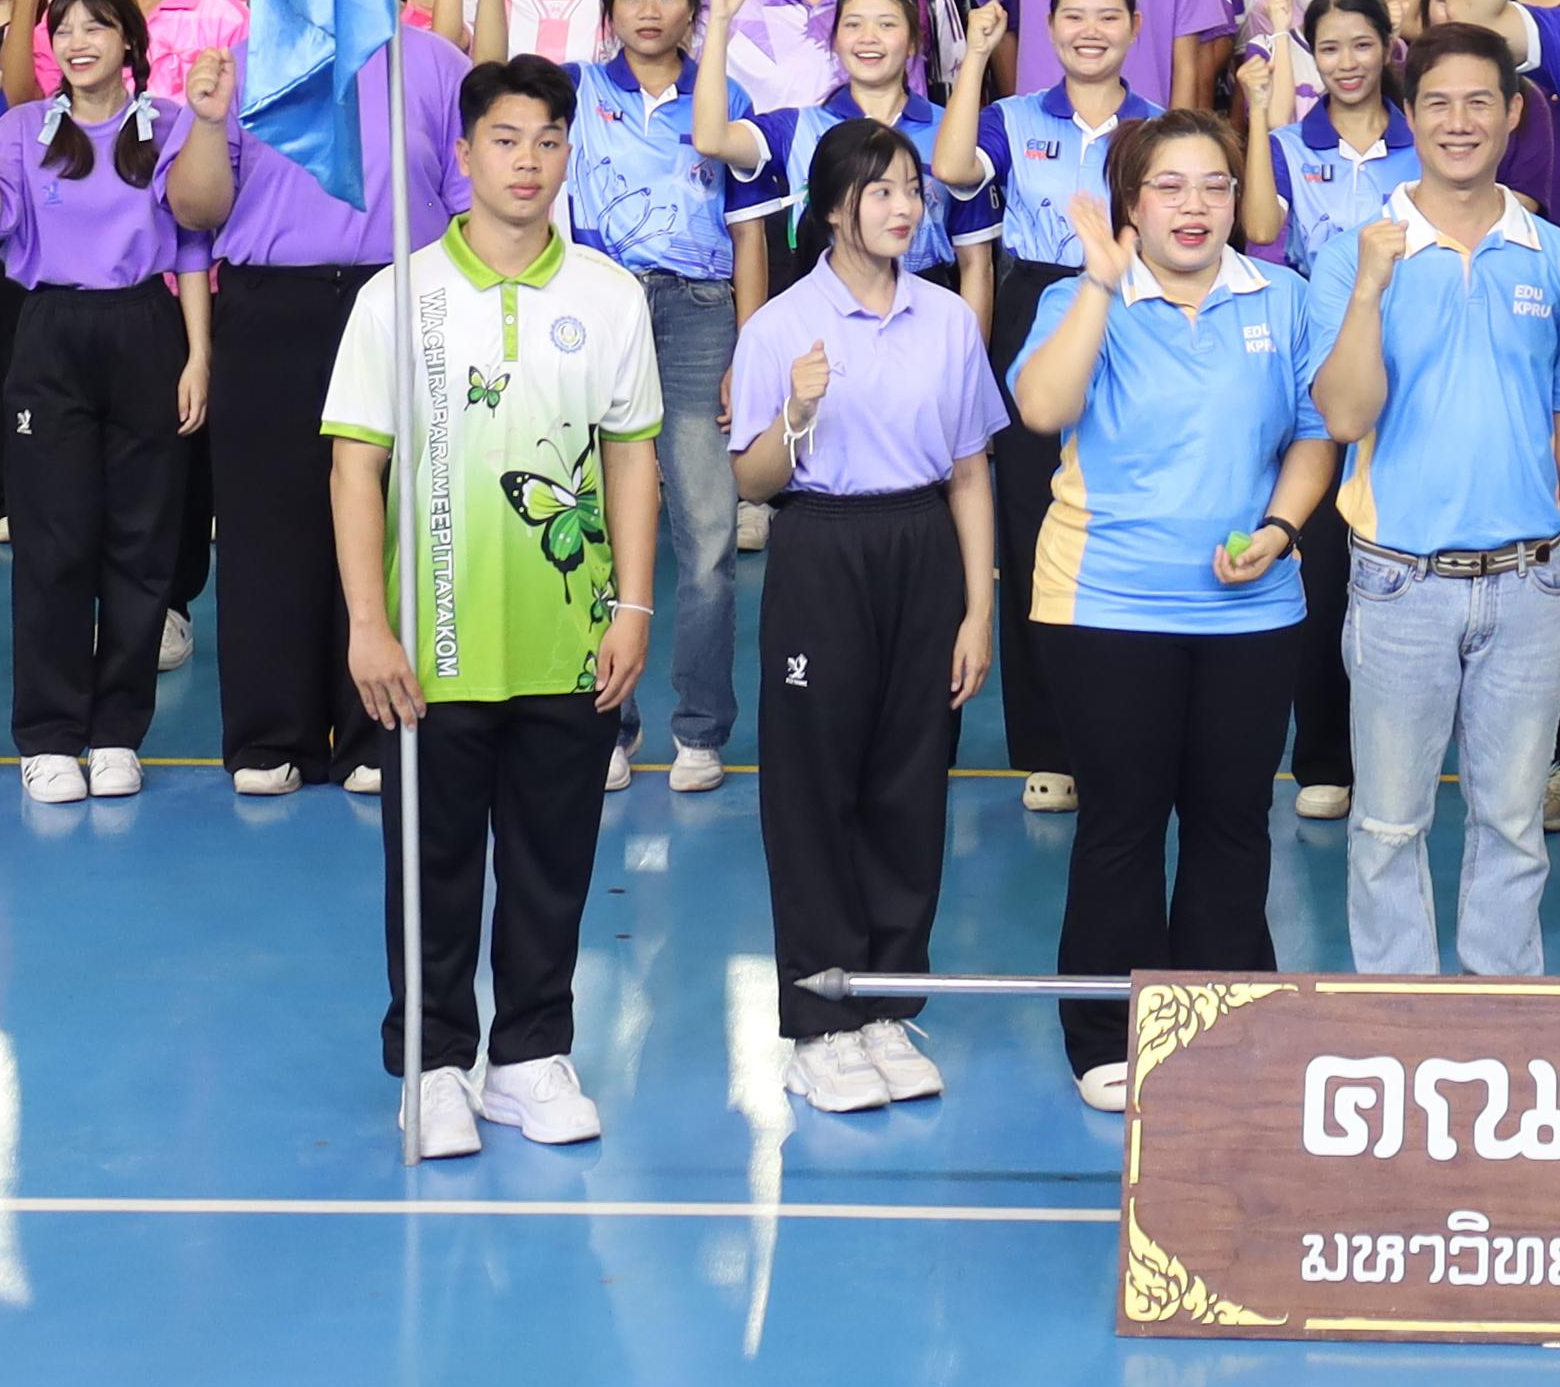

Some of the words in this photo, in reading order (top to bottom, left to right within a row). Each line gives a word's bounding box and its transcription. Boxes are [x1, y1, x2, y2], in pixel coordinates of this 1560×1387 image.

[1026, 138, 1060, 160] EDU
[1514, 284, 1544, 302] EDU
[1512, 300, 1552, 319] KPRU
